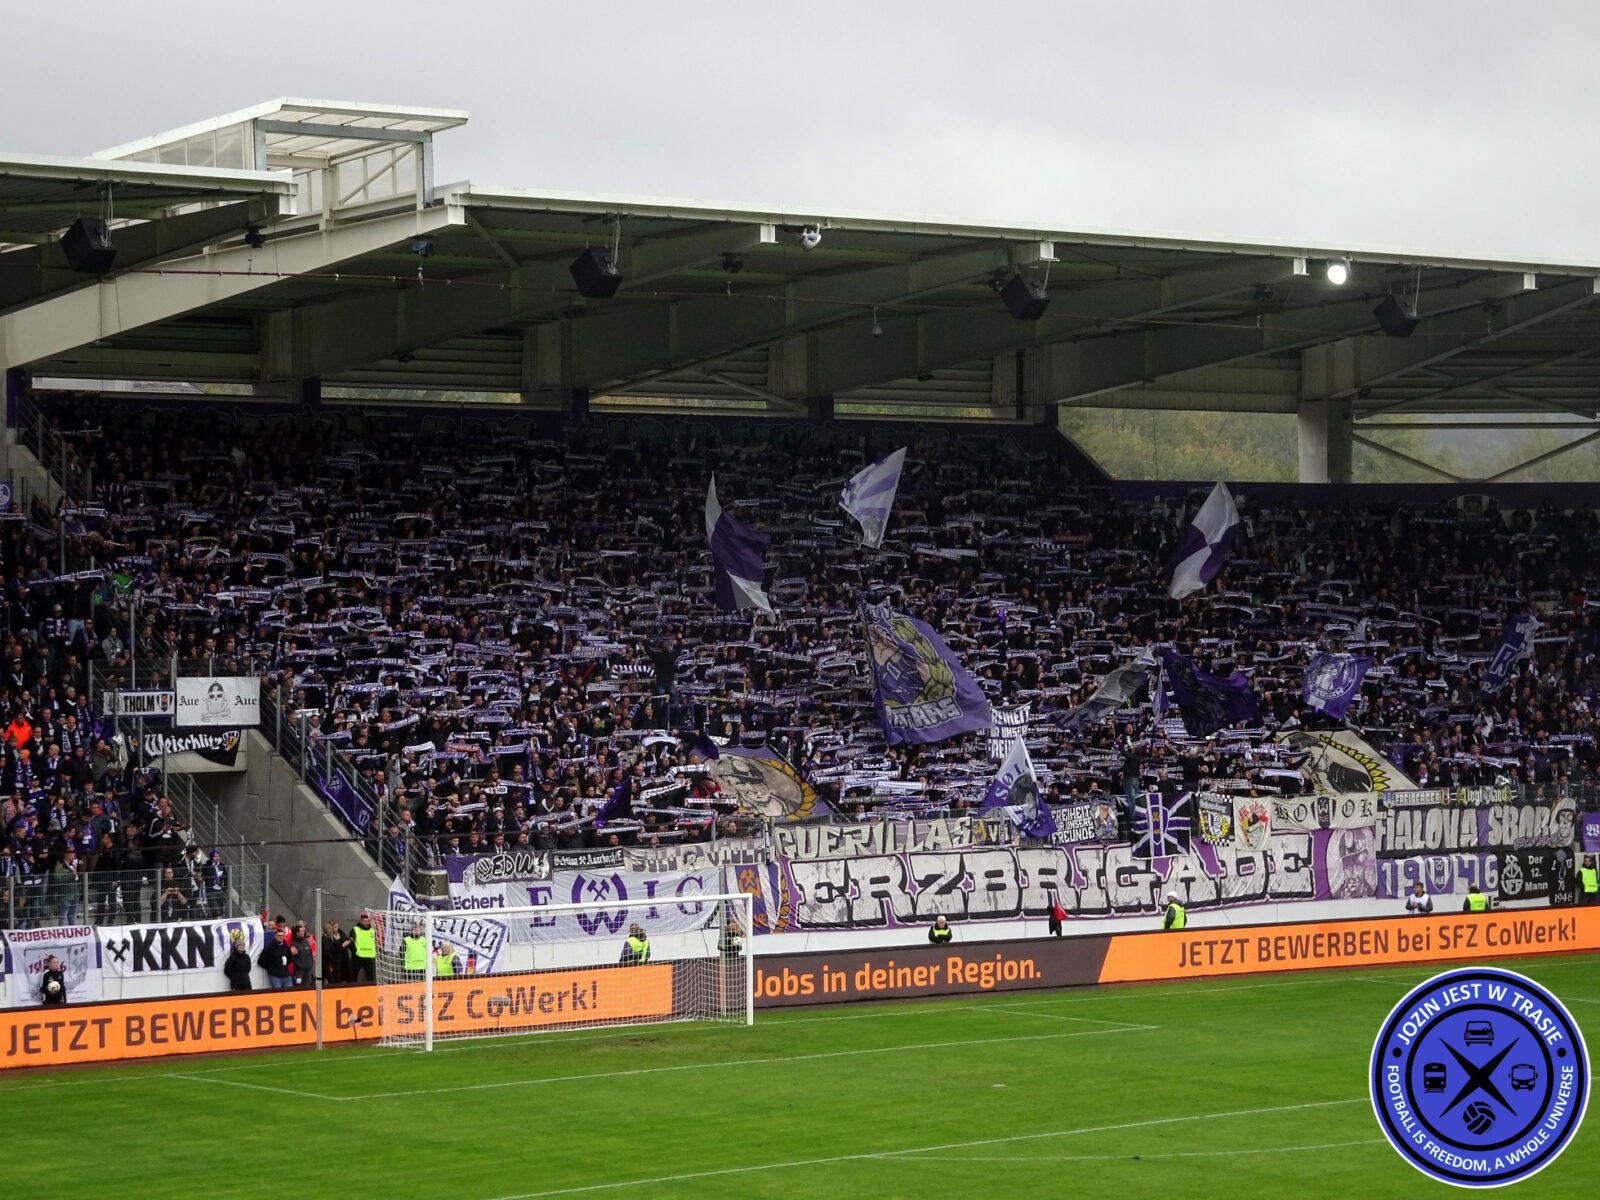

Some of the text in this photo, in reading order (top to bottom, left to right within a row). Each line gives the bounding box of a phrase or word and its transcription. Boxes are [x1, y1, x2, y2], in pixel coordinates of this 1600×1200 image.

[179, 695, 258, 706] Aue Aue
[988, 705, 1031, 725] REIHEIT
[144, 733, 223, 757] Weischlitz
[1051, 804, 1090, 822] FREIHEIT
[774, 816, 974, 860] GUERILLAS
[1052, 825, 1095, 845] FREUNDE
[1528, 854, 1544, 865] Der
[789, 828, 1315, 930] ERZBRIGADE
[1530, 868, 1542, 878] 12.
[1524, 881, 1549, 892] Mann
[1554, 892, 1573, 904] 1946
[8, 926, 92, 944] GRUBENHUND
[1178, 916, 1577, 968] JETZT BEWERBEN bei SFZ CoWerk!
[130, 924, 216, 973] KKN
[754, 953, 1042, 999] Jobs in deiner Region.
[6, 1017, 113, 1057] JETZT
[125, 1002, 318, 1047] BEWERBEN
[335, 996, 384, 1031] bei
[466, 980, 598, 1020] CoWerk!
